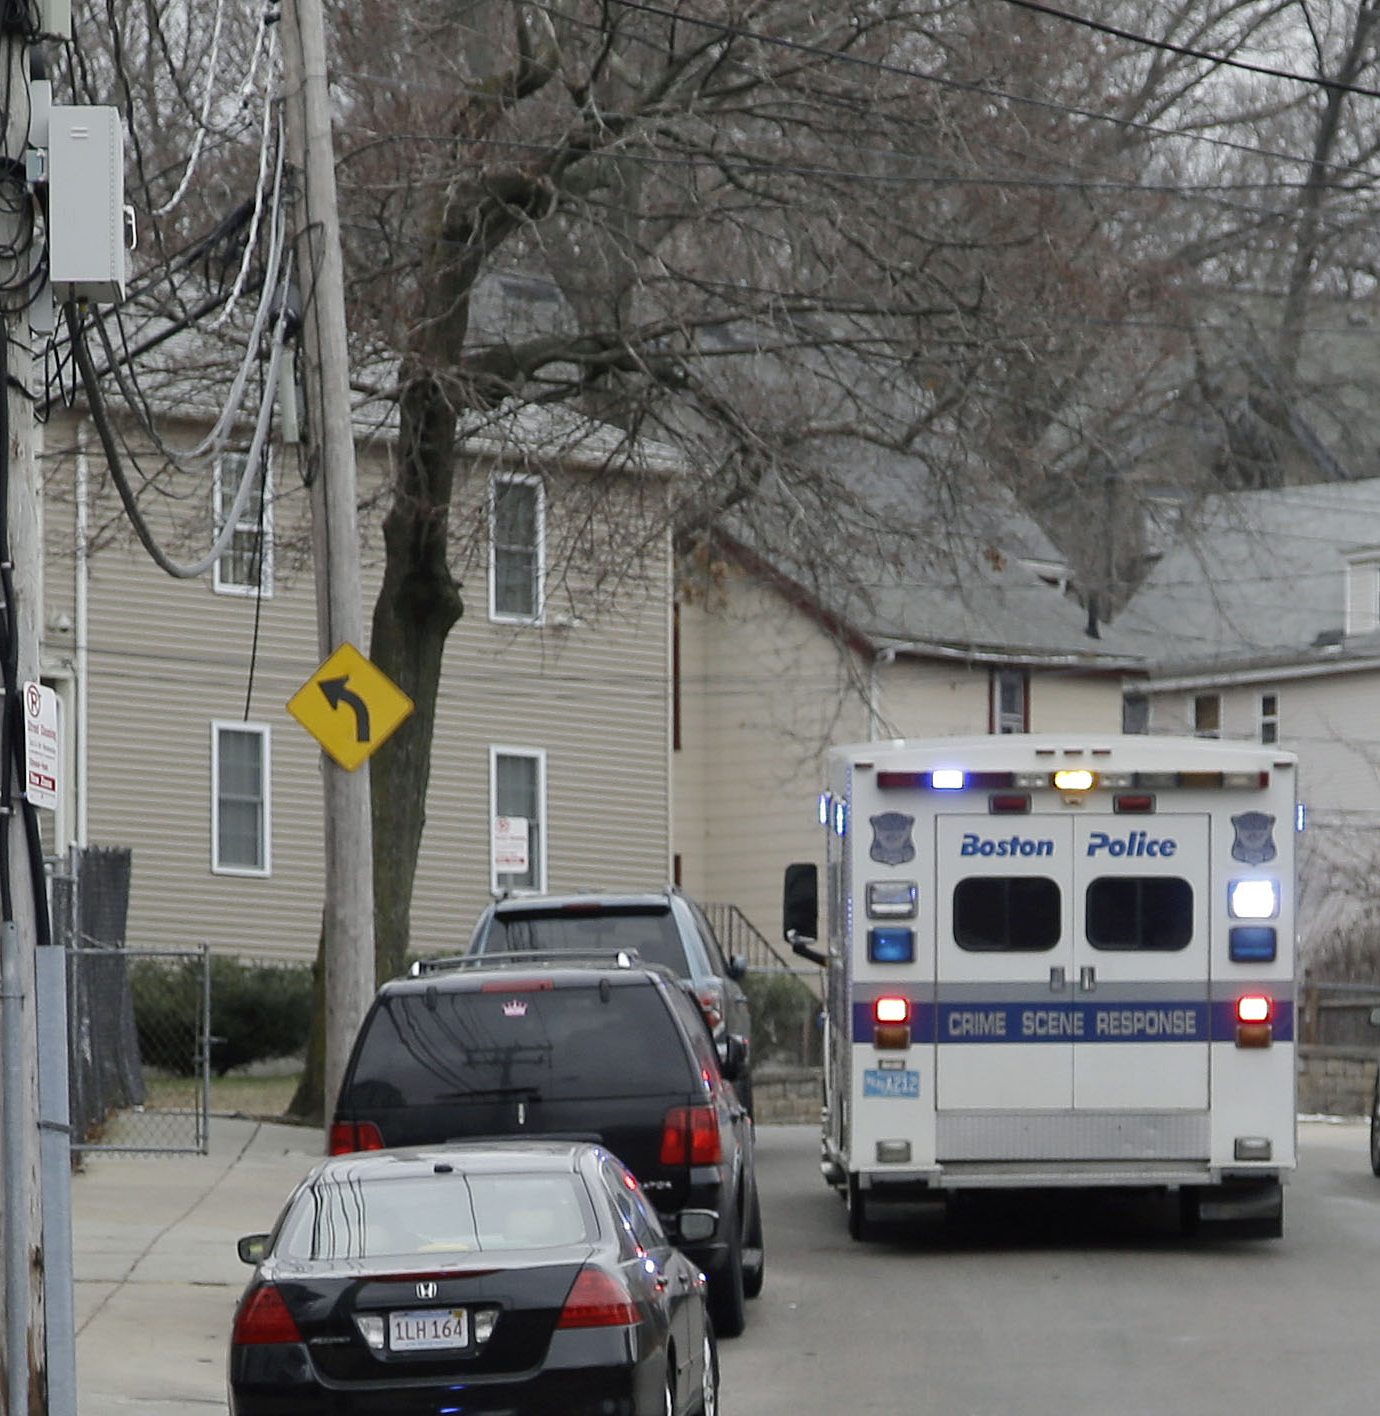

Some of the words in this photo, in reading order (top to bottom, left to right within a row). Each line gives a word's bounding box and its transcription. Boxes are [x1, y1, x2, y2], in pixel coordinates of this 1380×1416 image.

[960, 833, 1054, 857] Boston
[1087, 831, 1177, 857] Police
[948, 1011, 1006, 1036] CRIME
[1022, 1011, 1084, 1036] SCENE
[1096, 1010, 1196, 1035] RESPONSE
[395, 1322, 426, 1341] 1LH
[432, 1319, 462, 1339] 164
